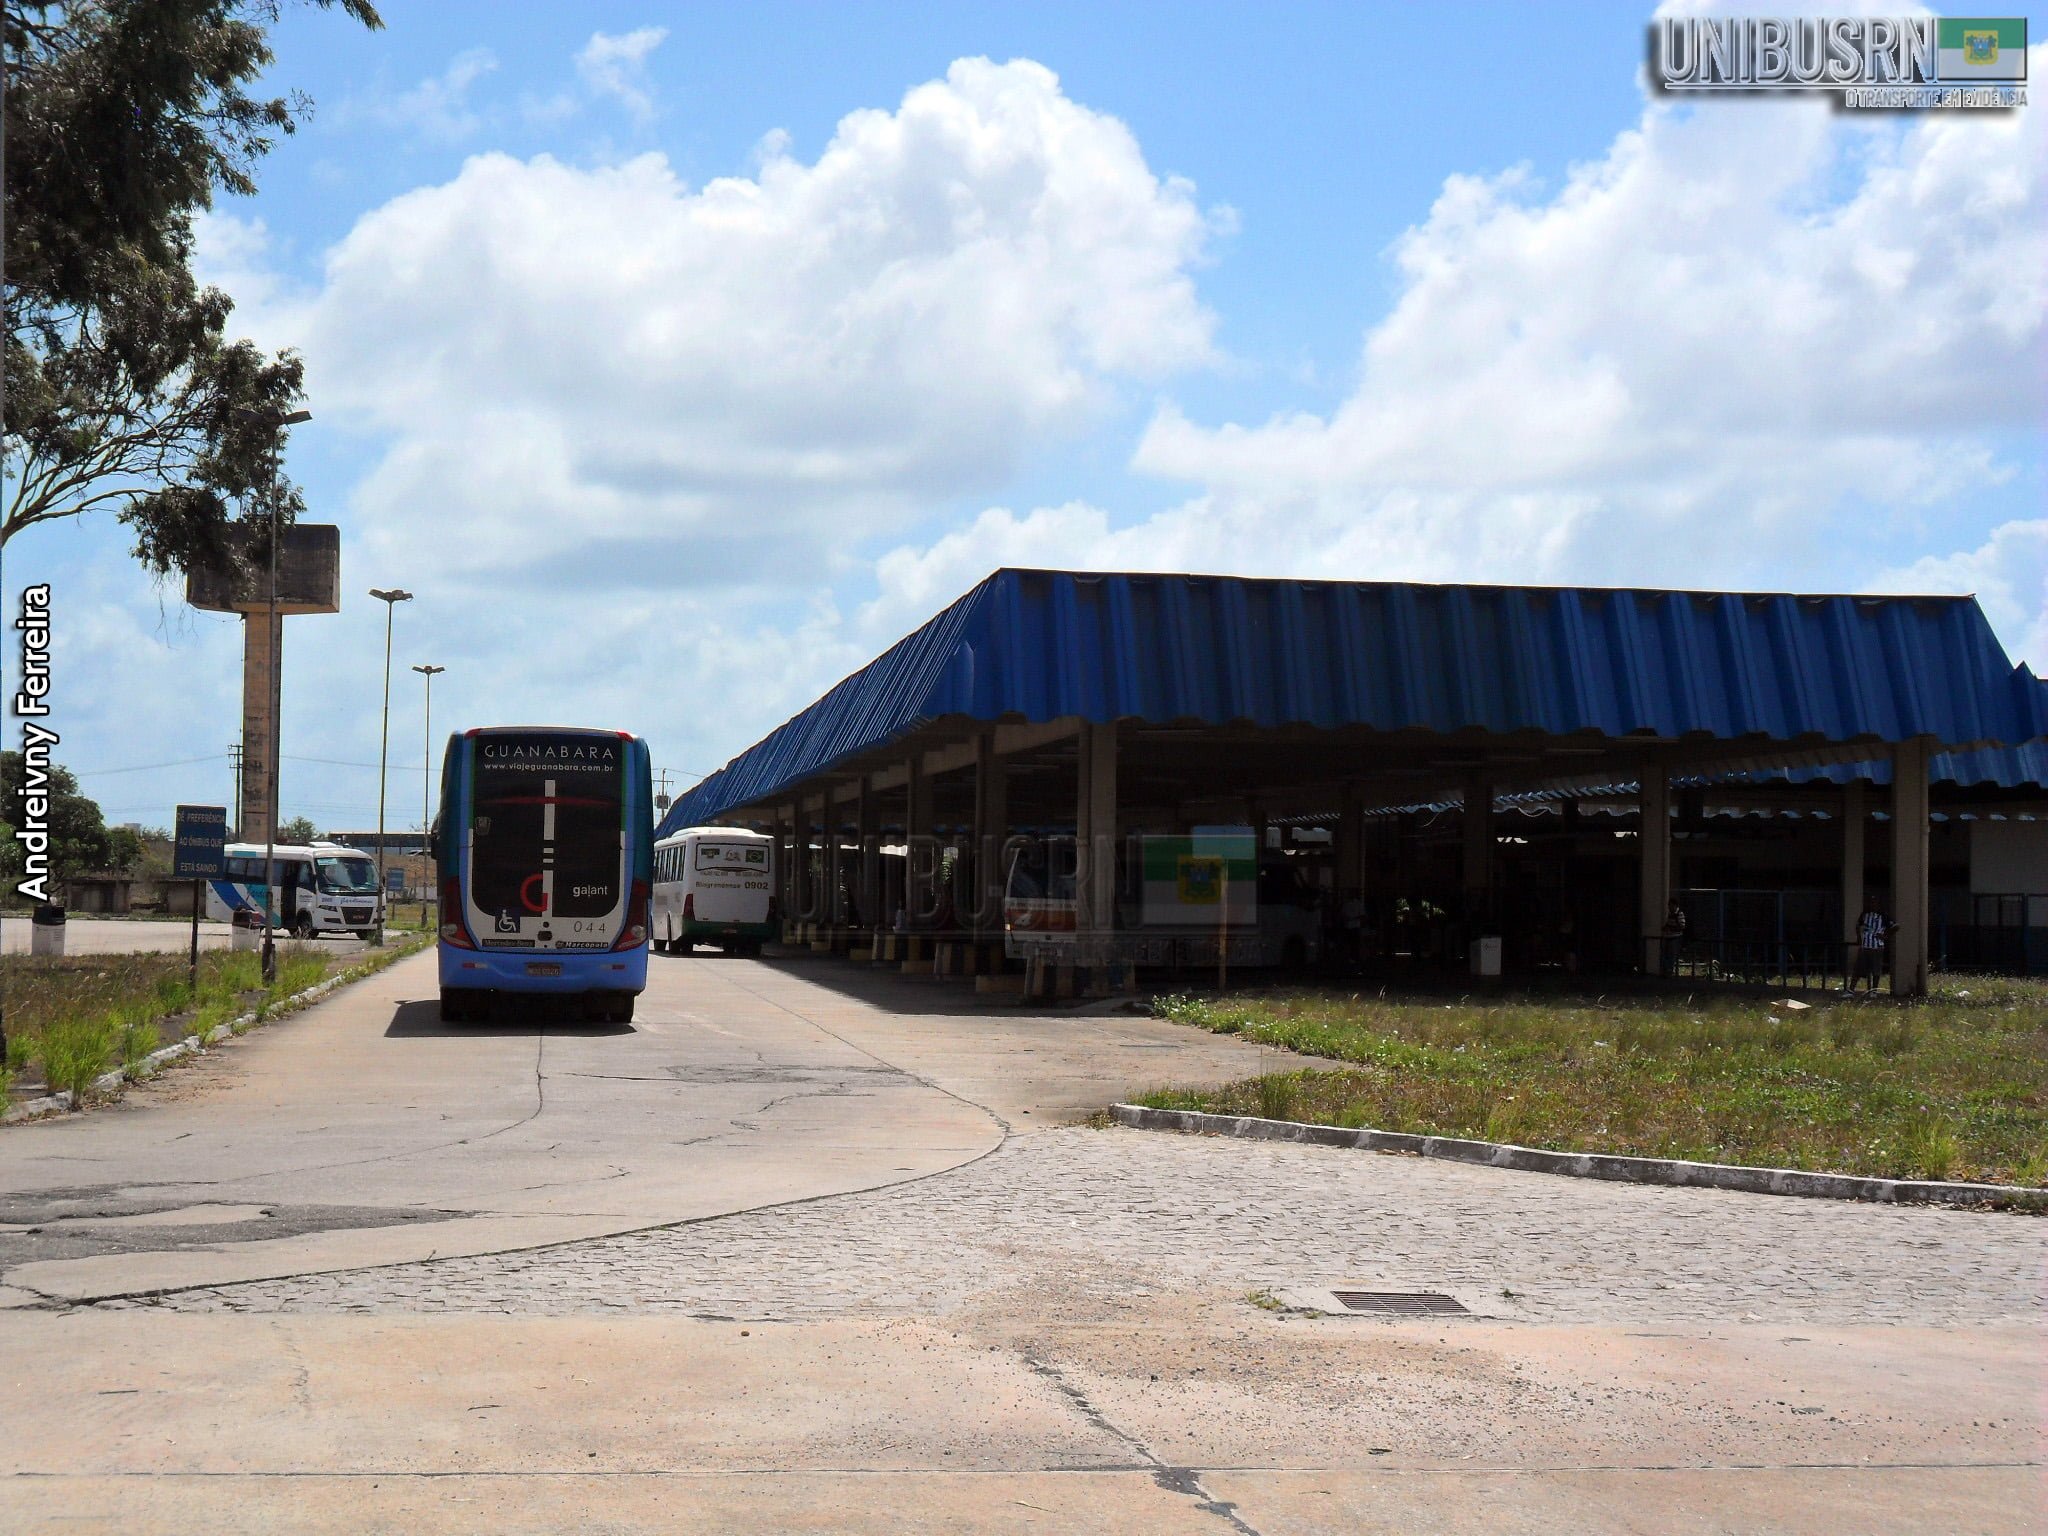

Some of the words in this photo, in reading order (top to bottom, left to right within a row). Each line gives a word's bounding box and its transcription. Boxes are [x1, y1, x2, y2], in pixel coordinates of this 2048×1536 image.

[484, 745, 614, 760] GUANABARA
[484, 763, 613, 772] www.viajeguanabara.com.br
[210, 838, 223, 848] QUE
[181, 861, 195, 872] ESTÁ
[572, 884, 609, 897] galant
[744, 881, 769, 890] 0902
[573, 920, 607, 934] 044
